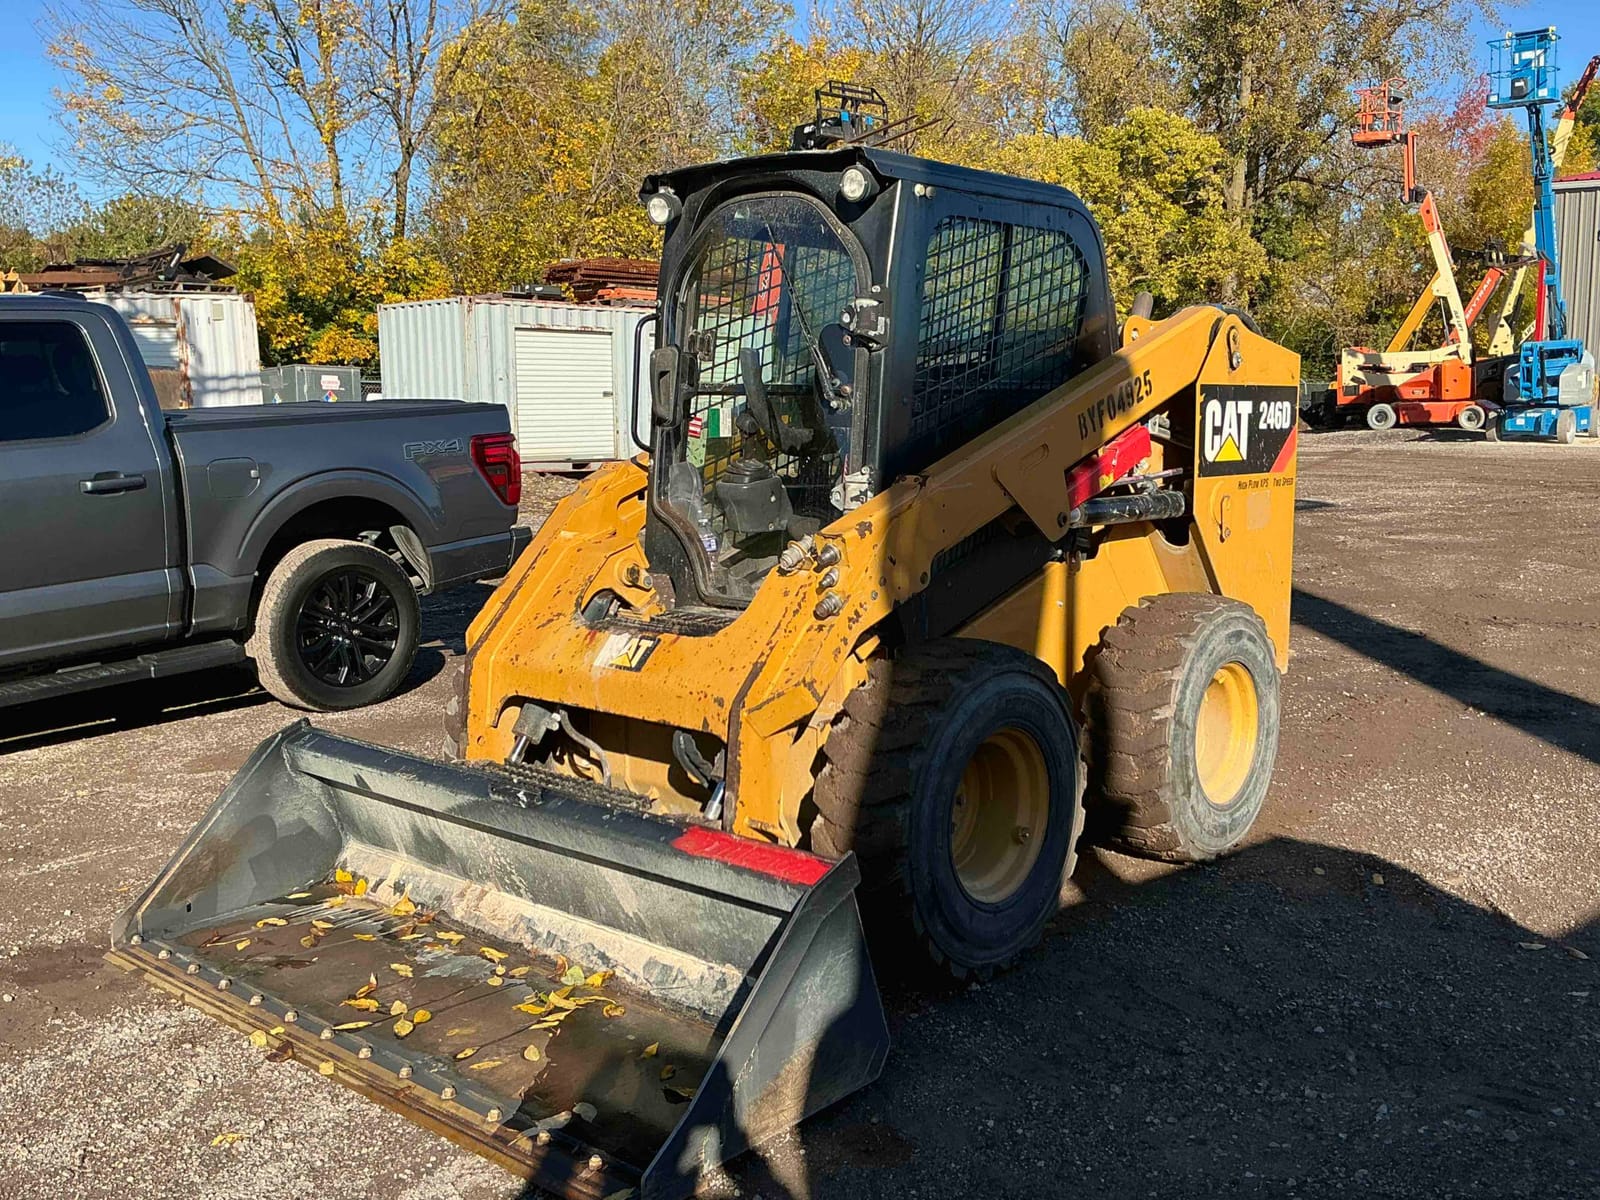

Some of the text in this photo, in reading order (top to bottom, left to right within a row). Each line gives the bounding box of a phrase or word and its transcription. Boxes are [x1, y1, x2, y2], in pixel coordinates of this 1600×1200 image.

[402, 438, 464, 461] FX4
[1204, 399, 1292, 463] CAT 246D
